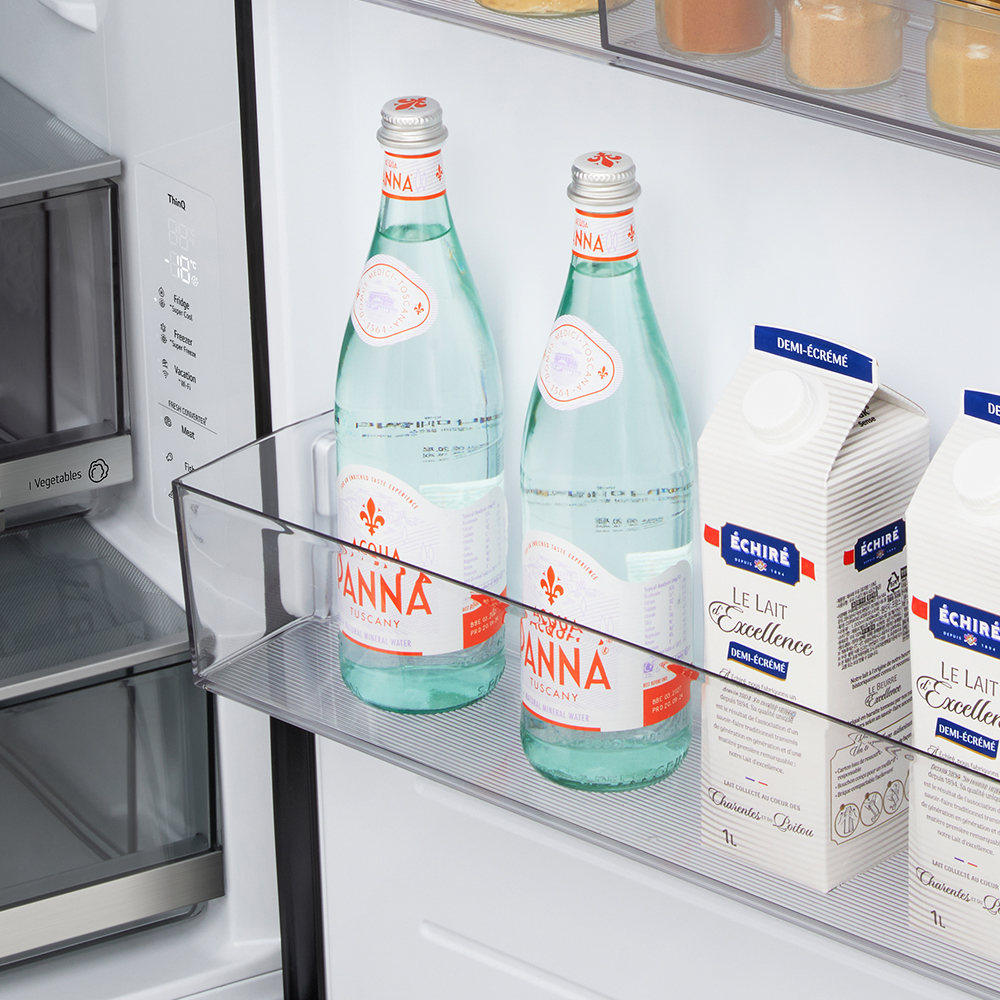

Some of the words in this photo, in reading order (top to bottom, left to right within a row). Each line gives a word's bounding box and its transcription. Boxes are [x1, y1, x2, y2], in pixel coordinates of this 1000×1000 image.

[167, 193, 187, 211] ThinQ
[173, 294, 190, 310] Fridge
[367, 267, 395, 281] MEDICI
[392, 279, 411, 327] TOSCANA
[174, 329, 193, 346] Freezer
[366, 322, 387, 335] 1564
[183, 346, 197, 358] Freeze
[554, 329, 580, 343] MEDICI
[574, 342, 595, 391] TOSCANA
[777, 336, 849, 368] DEMI-ÉCRÉMÉ
[174, 365, 197, 384] Vacation
[550, 383, 571, 398] 1564
[168, 400, 182, 412] FRESH
[181, 425, 195, 440] Meat
[858, 416, 876, 427] Sense
[34, 470, 82, 489] Vegetables
[371, 476, 386, 487] TASTE
[388, 484, 419, 510] EXPERIENCE
[730, 531, 791, 568] ÉCHIRÉ
[860, 526, 900, 557] ÉCHIRÉ
[551, 544, 566, 555] TASTE
[568, 553, 598, 580] EXPERIENCE
[734, 557, 752, 566] DEPUIS
[732, 586, 750, 609] LE
[755, 593, 788, 620] LAIT
[350, 606, 401, 629] TUSCANY
[470, 618, 481, 628] BBE
[364, 631, 389, 645] MINERAL
[391, 637, 412, 648] WATER
[943, 631, 962, 641] DEPUIS
[730, 647, 786, 674] DEMI-ÉCRÉMÉ
[530, 677, 579, 702] TUSCANY
[868, 686, 876, 694] LE
[876, 674, 898, 692] BEURRE
[941, 661, 959, 684] LE
[965, 669, 999, 697] LAIT
[542, 704, 566, 719] MINERAL
[568, 710, 590, 722] WATER
[720, 725, 746, 741] génération
[753, 737, 780, 752] génération
[745, 723, 774, 739] traditionnel
[775, 733, 798, 746] transmis
[938, 724, 996, 752] DEMI-ÉCRÉMÉ
[737, 742, 760, 756] première
[760, 750, 793, 767] remarquable
[723, 780, 735, 789] LAIT
[735, 785, 761, 799] COLLECTÉ
[762, 793, 770, 801] AU
[770, 796, 789, 807] COEUR
[790, 802, 801, 811] DES
[708, 787, 761, 821] Charentes
[772, 812, 814, 838] Poitou
[722, 828, 737, 847] 1L
[916, 866, 970, 902] Charentes
[932, 859, 943, 868] LAIT
[944, 864, 970, 880] COLLECTÉ
[970, 873, 979, 883] AU
[980, 876, 1000, 889] COEUR
[930, 910, 945, 929] 1L
